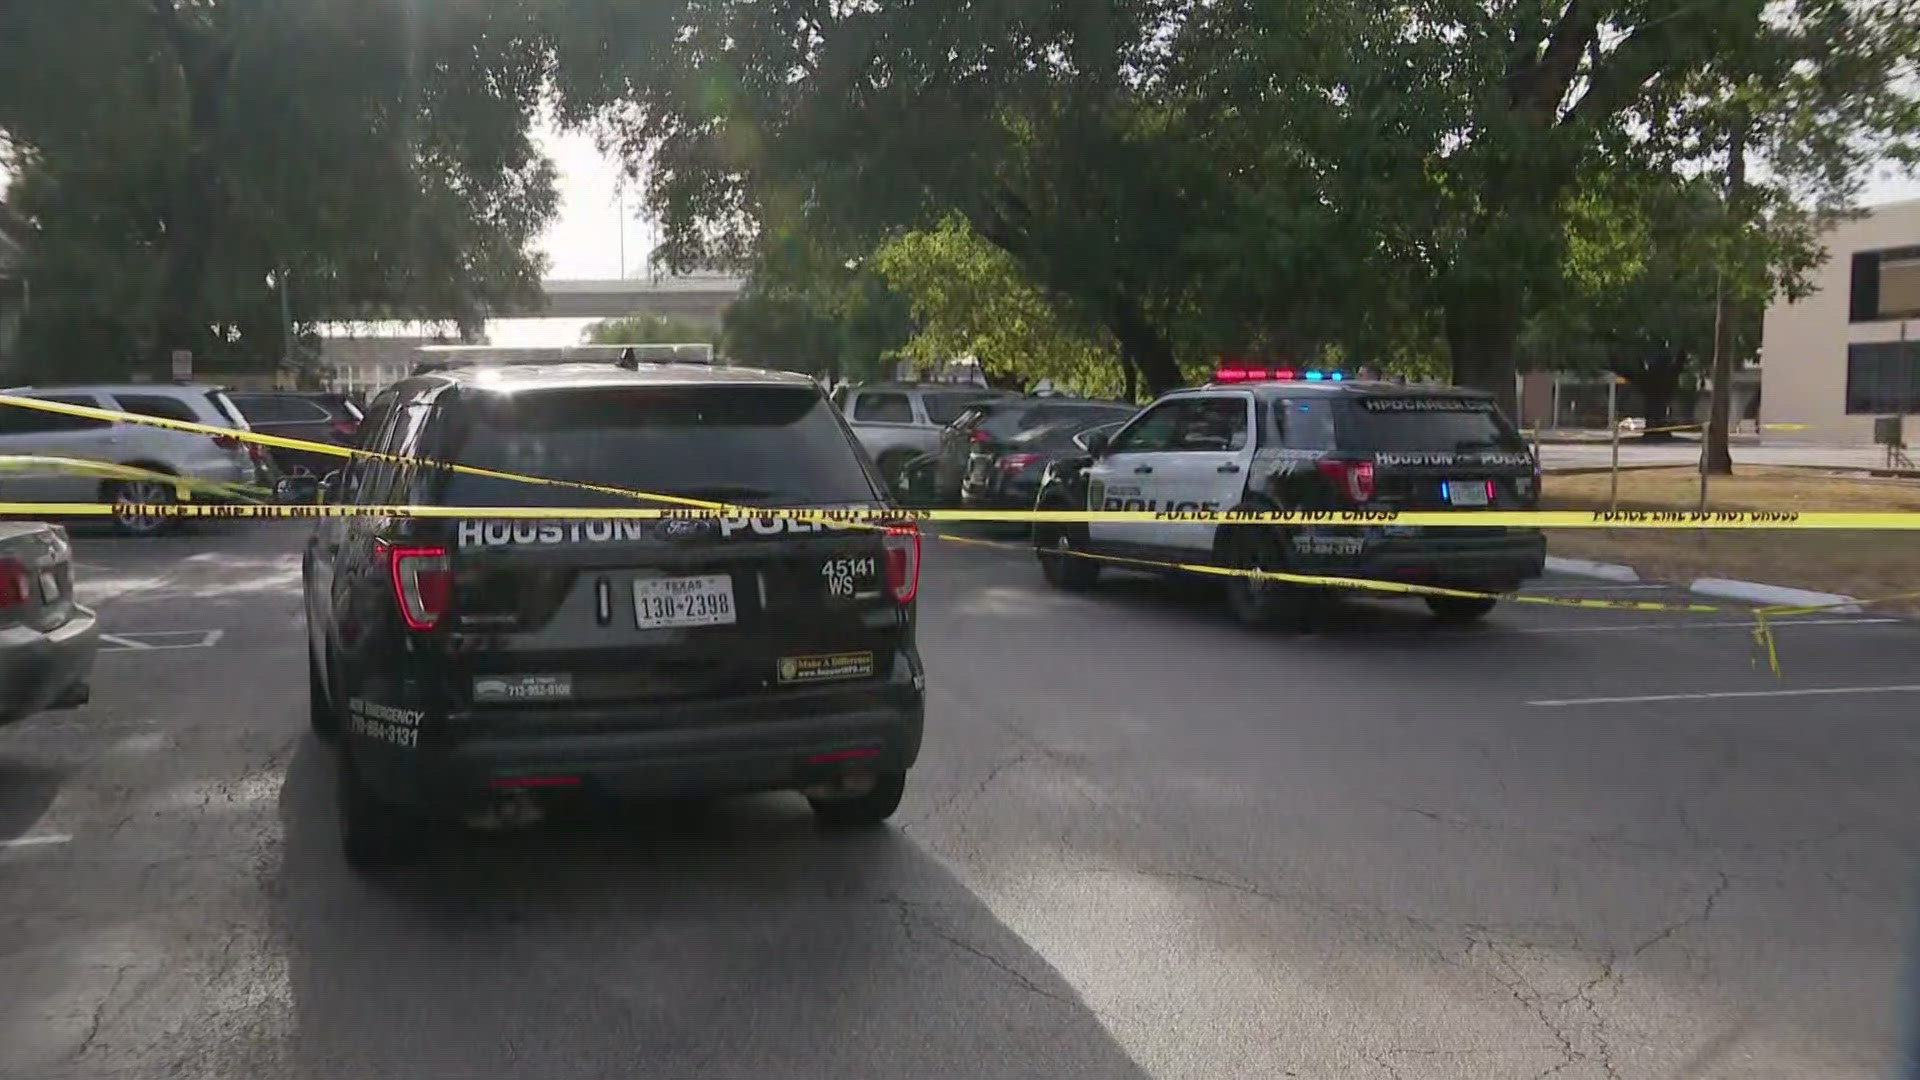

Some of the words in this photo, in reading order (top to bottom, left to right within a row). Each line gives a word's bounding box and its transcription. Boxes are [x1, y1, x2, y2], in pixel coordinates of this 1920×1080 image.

[1375, 451, 1454, 465] HOUSTON
[1482, 451, 1533, 463] POLICE
[458, 518, 642, 547] HOUSTON
[822, 558, 875, 577] 45141
[666, 580, 702, 592] TEXAS
[828, 576, 854, 595] WS
